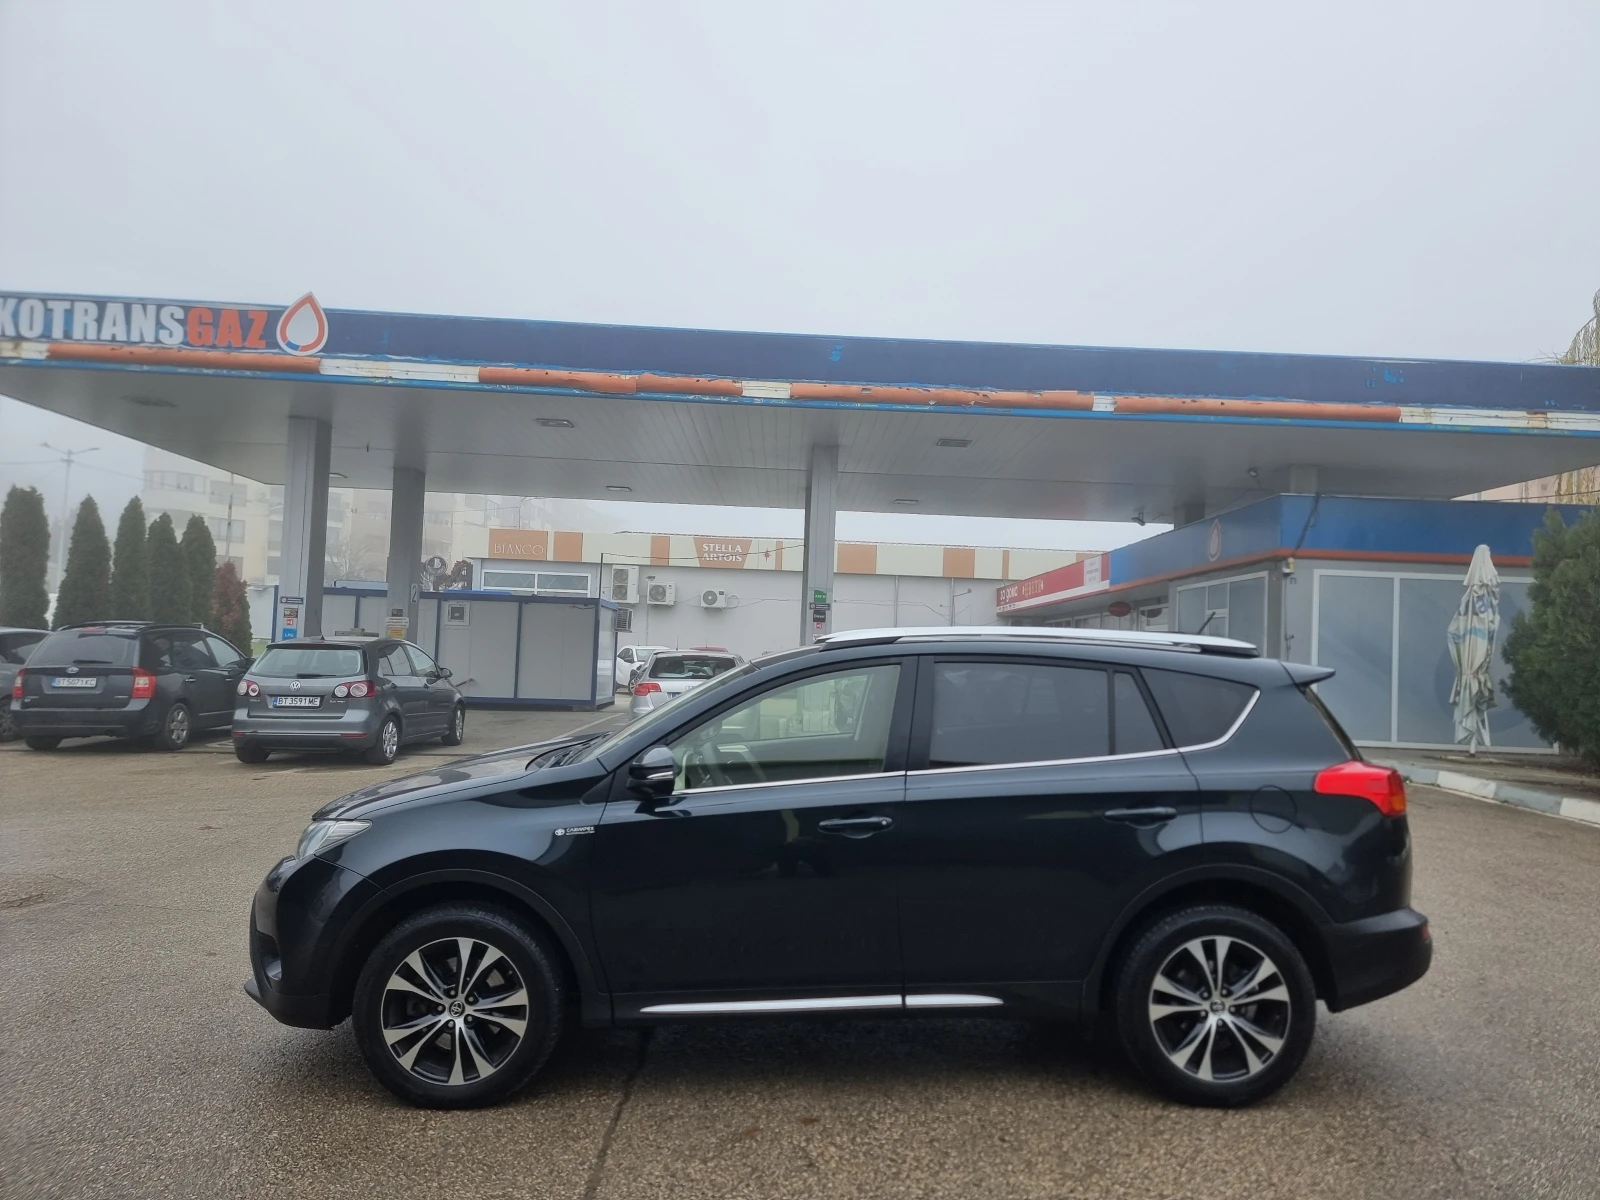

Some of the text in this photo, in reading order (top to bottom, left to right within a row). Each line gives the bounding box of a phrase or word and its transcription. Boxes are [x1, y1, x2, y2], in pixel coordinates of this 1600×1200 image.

[494, 543, 544, 556] BIANCO
[702, 543, 742, 552] STELLA
[702, 553, 743, 562] ARTOIS
[411, 584, 417, 603] 2
